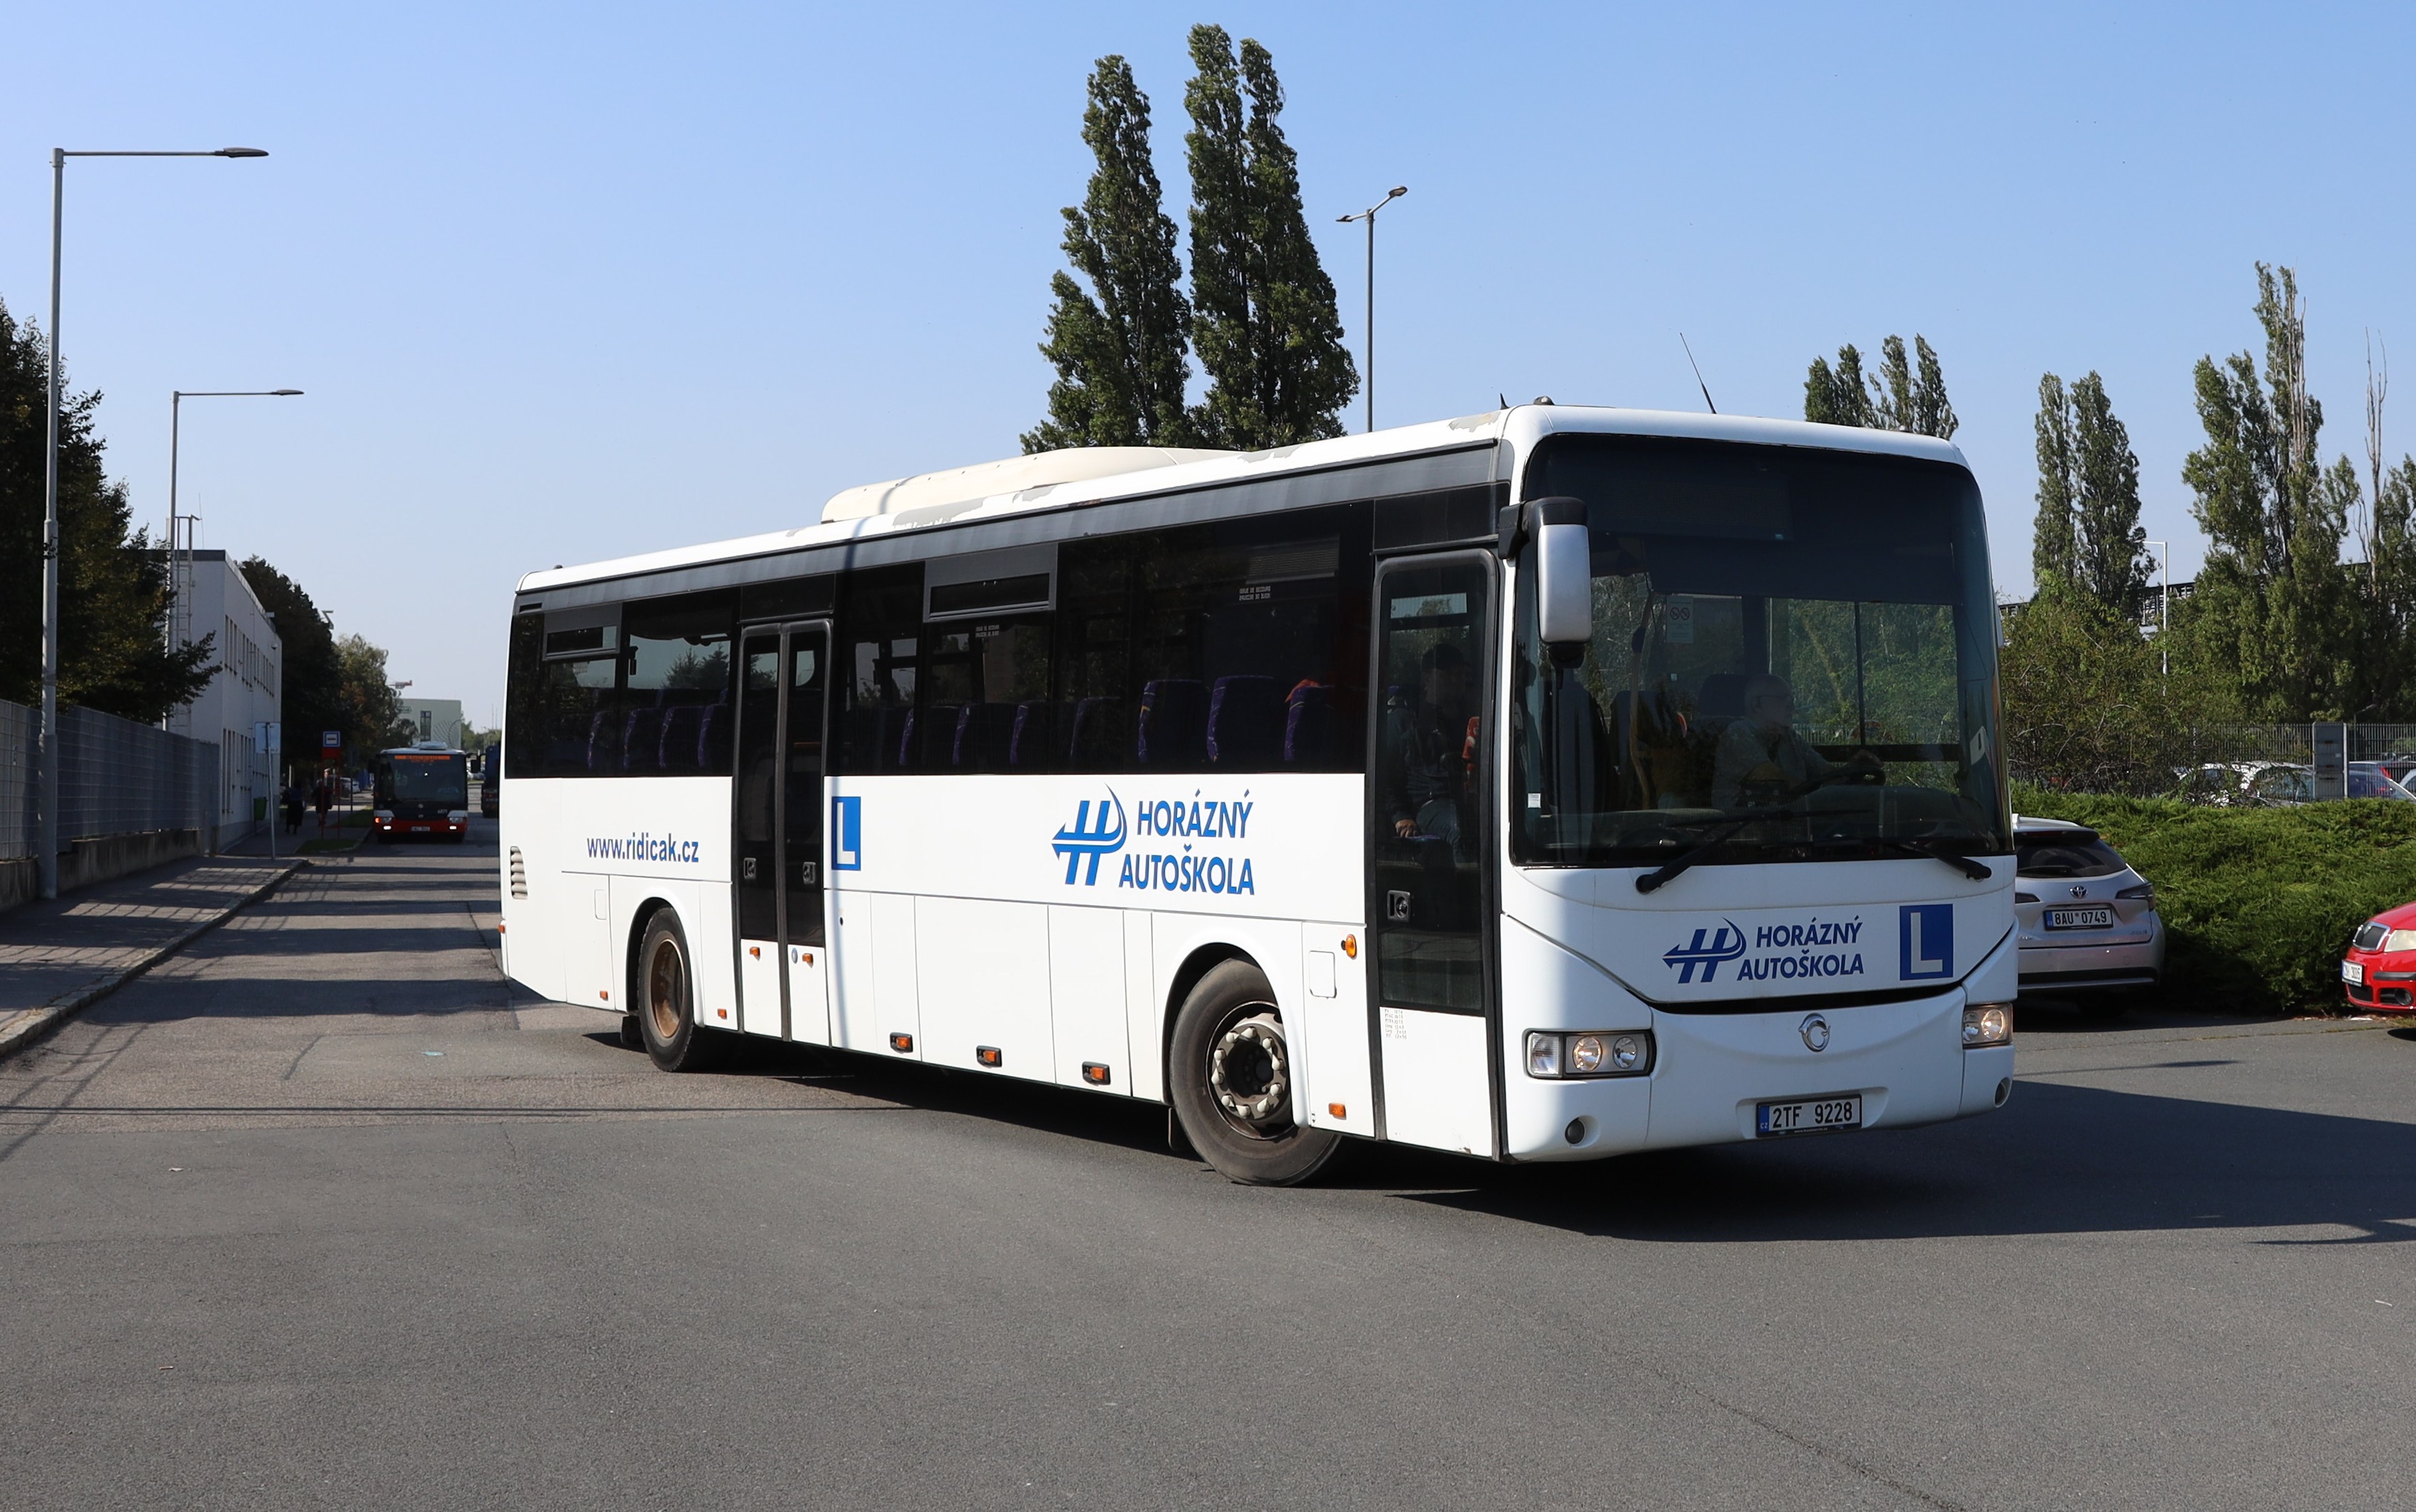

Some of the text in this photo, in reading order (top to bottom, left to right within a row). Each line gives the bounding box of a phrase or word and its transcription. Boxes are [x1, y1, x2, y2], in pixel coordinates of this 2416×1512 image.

[1136, 789, 1254, 838] HORÁZNÝ
[586, 832, 699, 862] www.ridicak.cz
[838, 802, 856, 864] L
[1118, 843, 1255, 895] AUTOŠKOLA
[1756, 915, 1863, 947] HORÁZNÝ
[2055, 911, 2107, 924] 8AU 0749
[1910, 912, 1943, 974] L
[1737, 949, 1864, 981] AUTOŠKOLA
[1773, 1101, 1853, 1128] 2TF 9228
